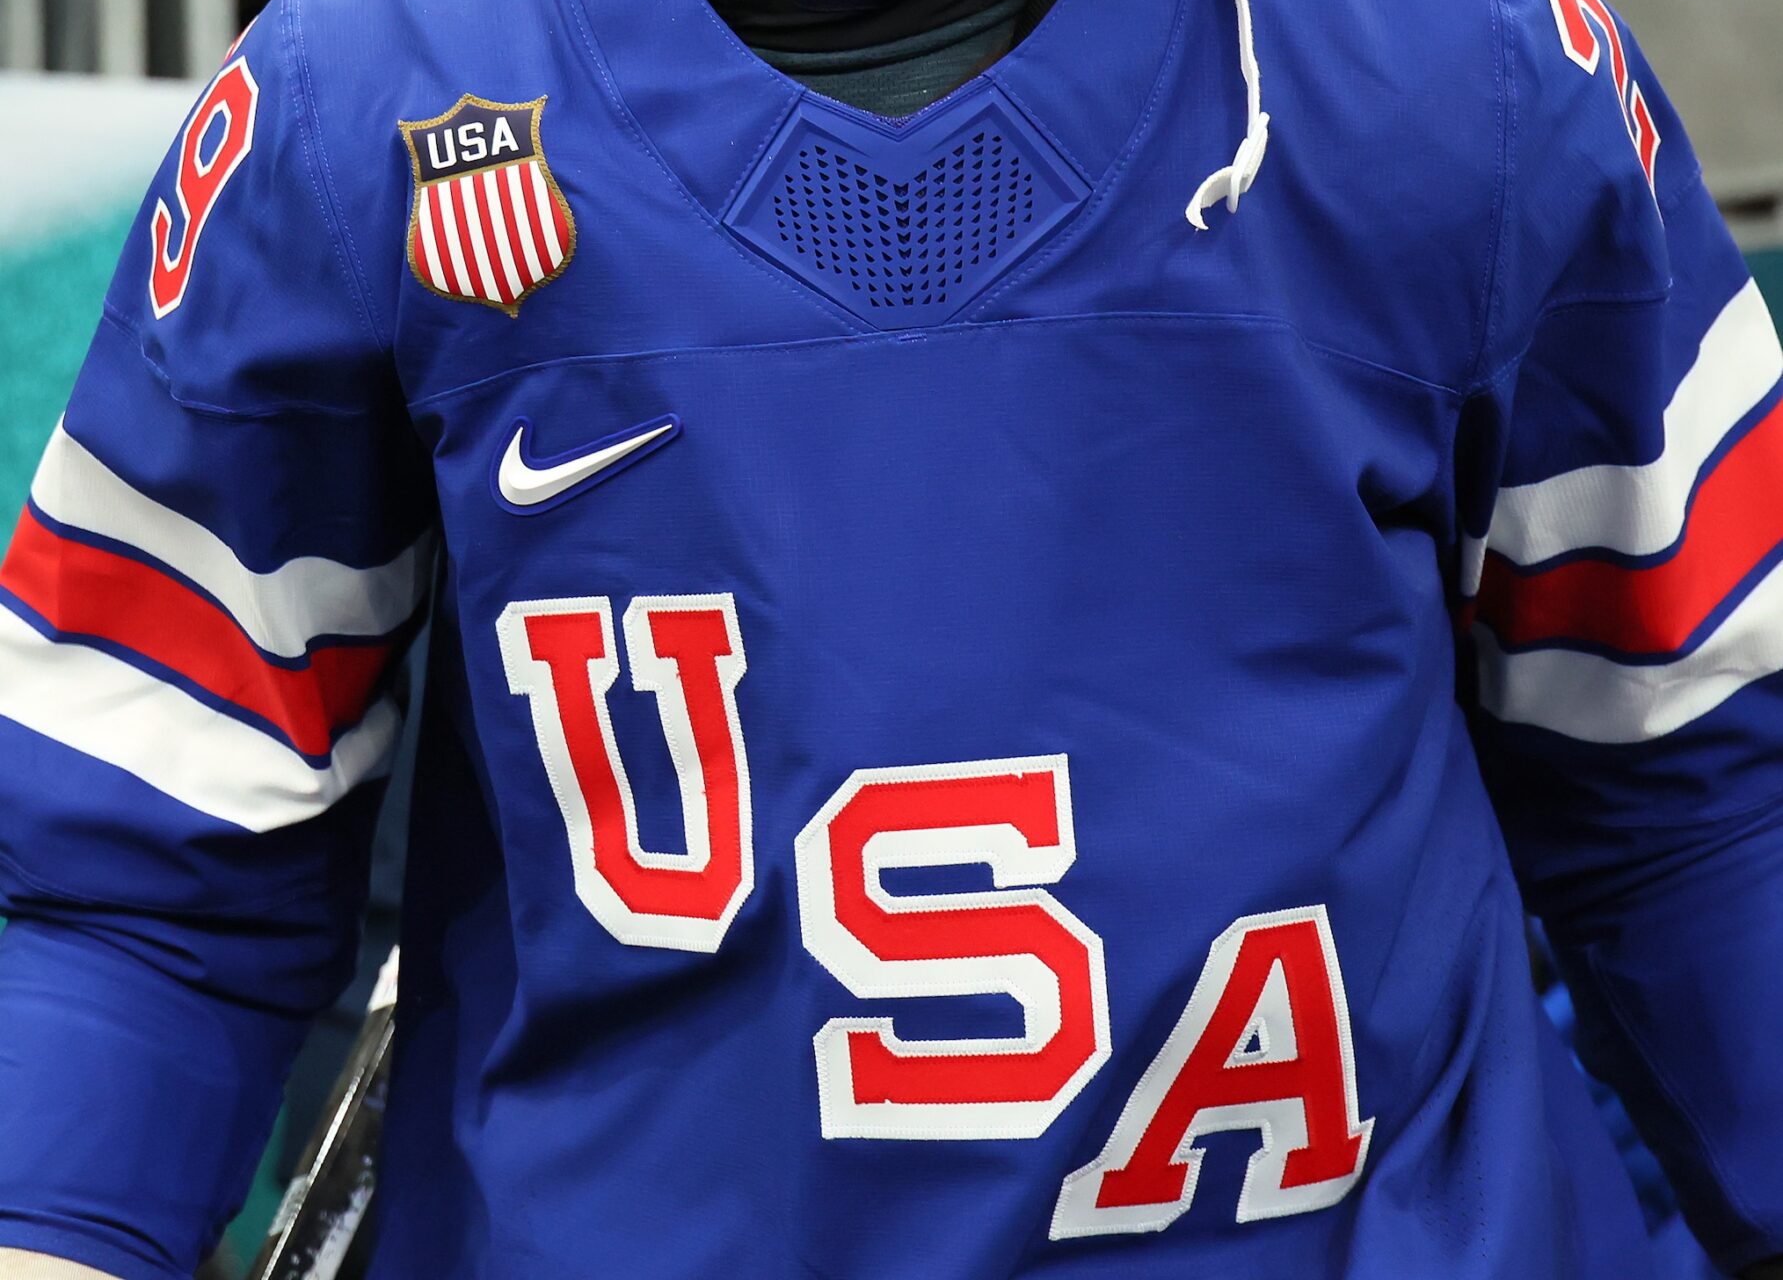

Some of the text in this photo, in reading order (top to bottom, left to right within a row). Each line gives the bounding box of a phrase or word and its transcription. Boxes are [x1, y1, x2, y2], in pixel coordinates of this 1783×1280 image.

[148, 20, 260, 322] 9
[426, 116, 520, 171] USA
[495, 591, 1376, 1242] USA
